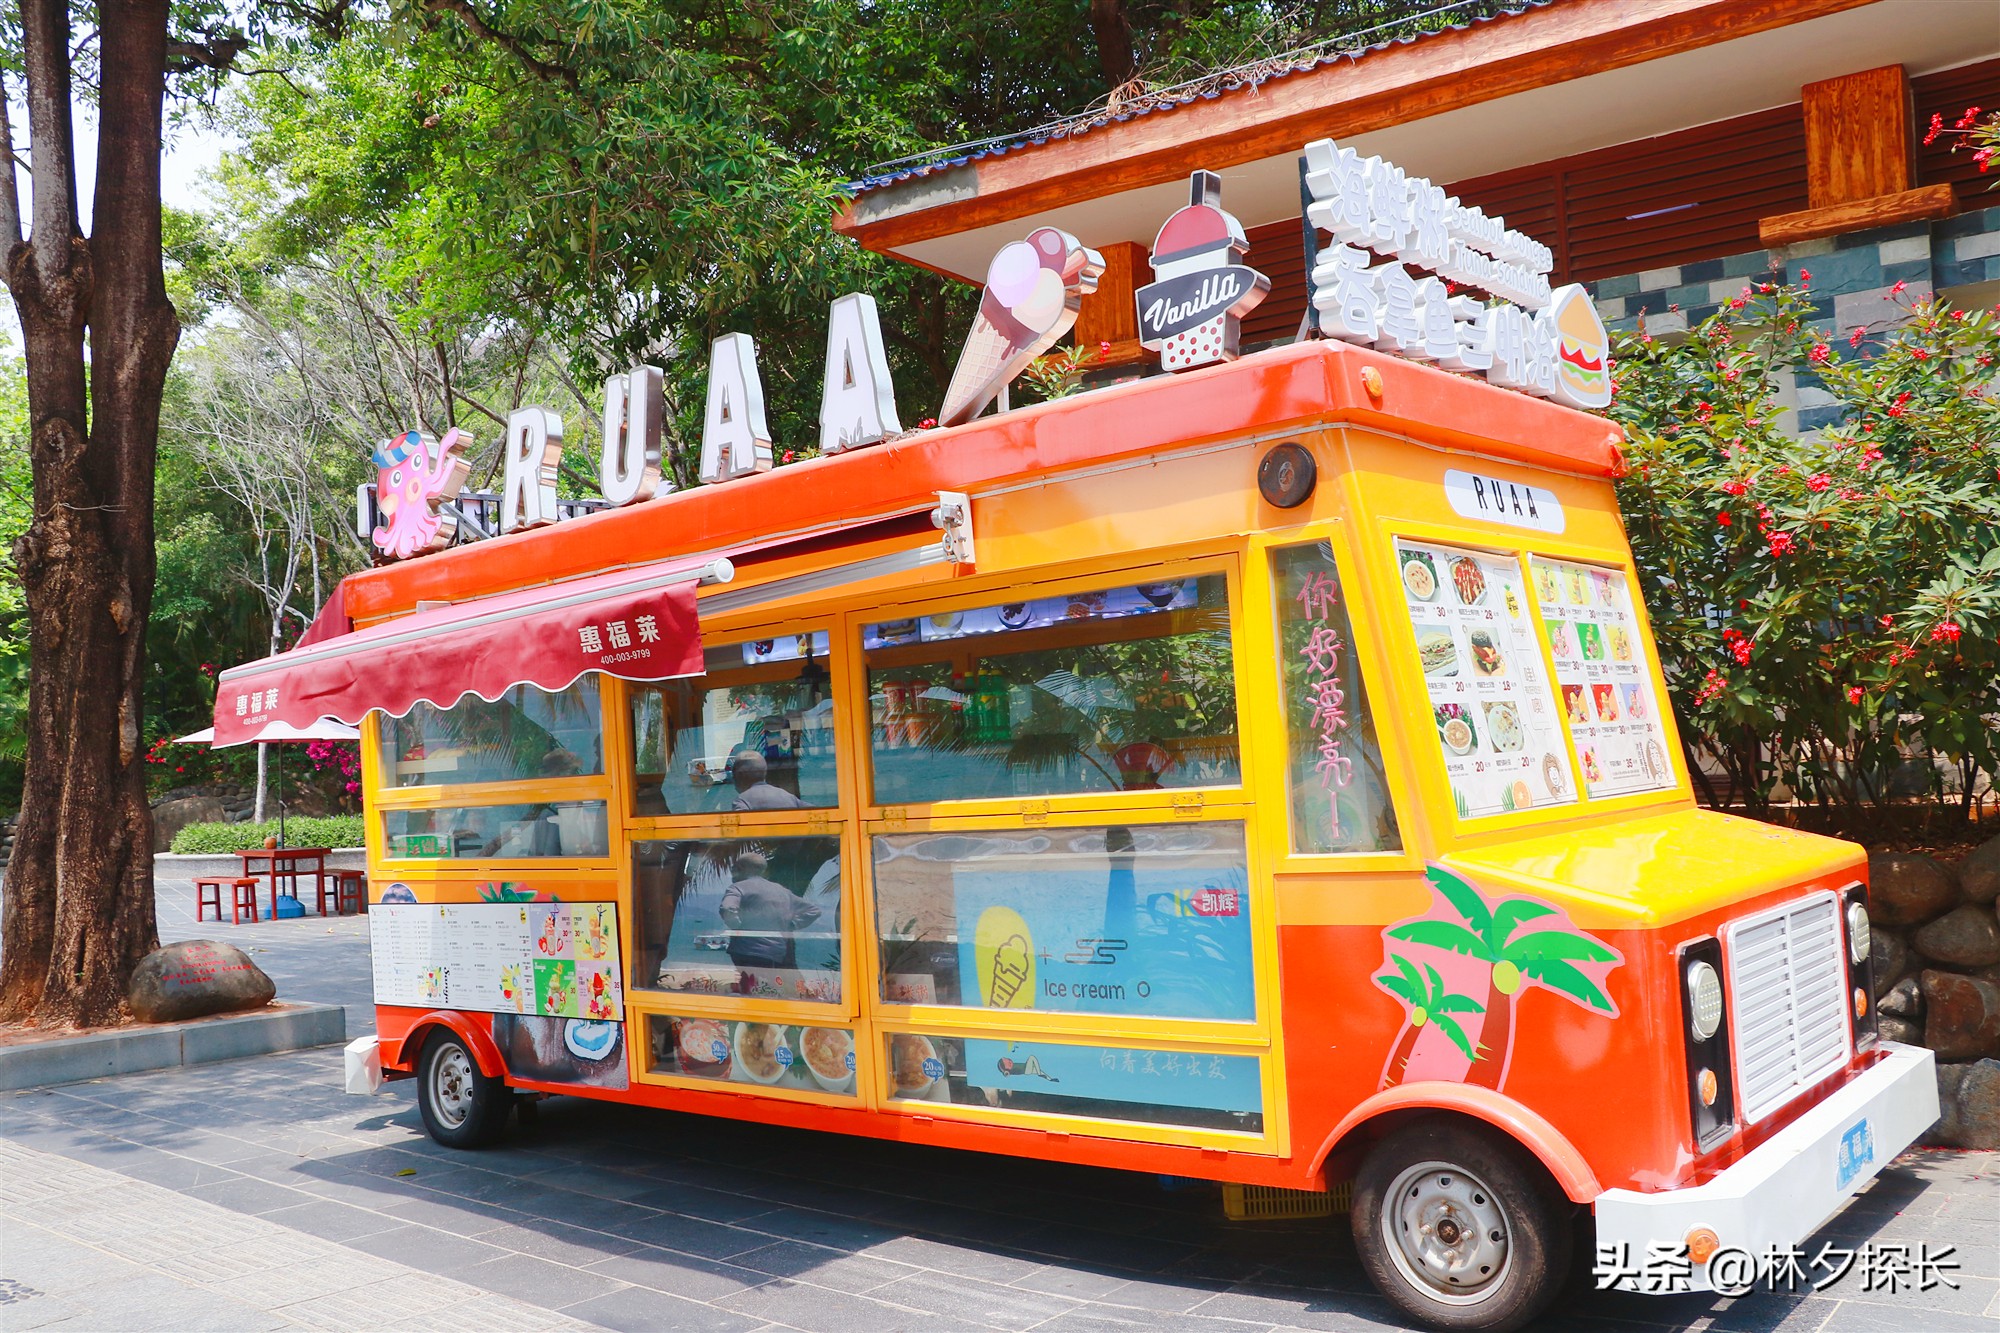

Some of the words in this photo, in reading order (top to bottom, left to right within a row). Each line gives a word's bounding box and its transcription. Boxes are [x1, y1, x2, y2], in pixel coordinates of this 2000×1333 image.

[1450, 197, 1504, 248] Seafood
[1509, 229, 1553, 270] congee
[1498, 260, 1552, 306] sandwich
[1143, 272, 1241, 333] Vanilla
[1320, 243, 1557, 394] 吞拿鱼三明治
[502, 293, 902, 534] RUAA
[1472, 475, 1539, 520] RUAA
[1436, 606, 1446, 617] 30
[1484, 609, 1494, 620] 28
[577, 614, 662, 653] 惠福莱
[600, 648, 651, 665] 400-003-9799
[1455, 681, 1465, 692] 20
[1502, 680, 1511, 691] 18
[235, 687, 279, 716] 惠福莱
[1475, 761, 1485, 772] 20
[1521, 756, 1530, 767] 20
[1202, 893, 1235, 912] 凯辉
[1044, 978, 1067, 998] Ice
[1071, 983, 1125, 1000] cream
[923, 1061, 934, 1071] 20
[1099, 1047, 1226, 1080] 向着美好出发
